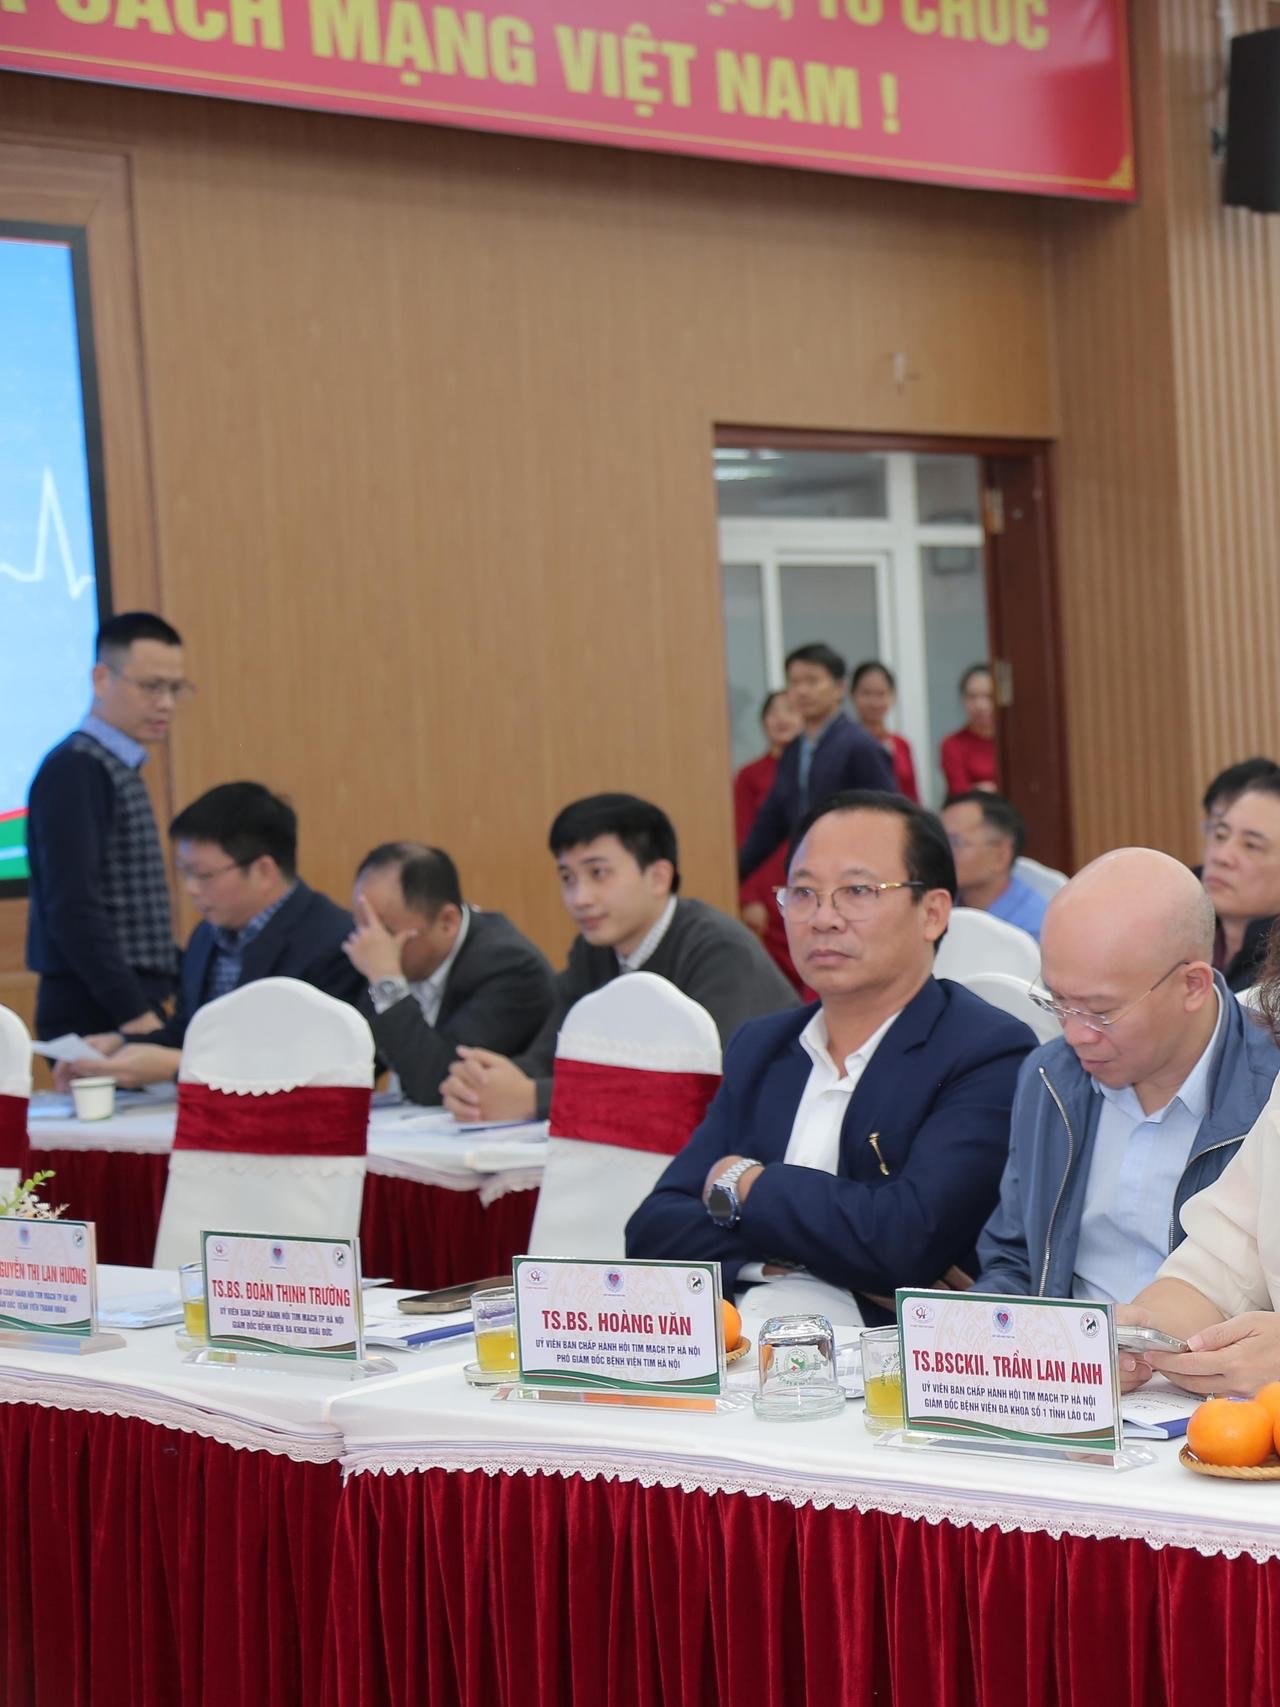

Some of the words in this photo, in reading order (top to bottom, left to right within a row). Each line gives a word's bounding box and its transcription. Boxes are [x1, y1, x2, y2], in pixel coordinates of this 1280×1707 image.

[312, 0, 536, 86] MẠNG
[554, 22, 696, 117] VIỆT
[716, 50, 861, 129] NAM
[879, 73, 899, 134] !
[41, 1265, 57, 1282] LAN
[212, 1280, 244, 1299] TS.BS.
[246, 1279, 274, 1301] ĐOÀN
[276, 1284, 306, 1307] THỊNH
[309, 1283, 351, 1307] TRƯỜNG
[542, 1311, 593, 1331] TS.BS.
[598, 1309, 653, 1334] HOÀNG
[658, 1311, 692, 1336] VĂN
[562, 1341, 577, 1349] BAN
[578, 1340, 596, 1350] CHẤP
[618, 1342, 630, 1354] HỘI
[631, 1345, 644, 1353] TIM
[645, 1345, 666, 1355] MẠCH
[668, 1346, 676, 1354] TP
[688, 1346, 701, 1357] NỘI
[606, 1356, 625, 1367] BỆNH
[626, 1357, 642, 1368] VIỆN
[643, 1359, 656, 1367] TIM
[668, 1359, 681, 1370] NỘI
[912, 1350, 989, 1376] TS.BSCKII.
[992, 1350, 1033, 1379] TRẦN
[1037, 1360, 1066, 1382] LAN
[1070, 1362, 1103, 1385] ANH
[932, 1383, 949, 1394] VIÊN
[950, 1386, 965, 1395] BAN
[966, 1385, 986, 1397] CHẤP
[987, 1387, 1007, 1399] HÀNH
[1008, 1389, 1021, 1402] HỘI
[1023, 1392, 1036, 1401] TIM
[1037, 1393, 1058, 1404] MẠCH
[1060, 1394, 1069, 1404] TP
[1071, 1394, 1081, 1405] HÀ
[1083, 1395, 1096, 1408] NỘI
[924, 1398, 943, 1409] GIÁM
[944, 1398, 959, 1410] ĐỐC
[960, 1400, 979, 1413] BỆNH
[980, 1402, 997, 1415] VIỆN
[998, 1405, 1009, 1414] ĐA
[1010, 1406, 1030, 1416] KHOA
[1031, 1405, 1041, 1417] SỐ
[1043, 1409, 1046, 1417] 1
[1049, 1408, 1066, 1419] TỈNH
[1067, 1409, 1081, 1420] LÀO
[1083, 1412, 1096, 1421] CAI
